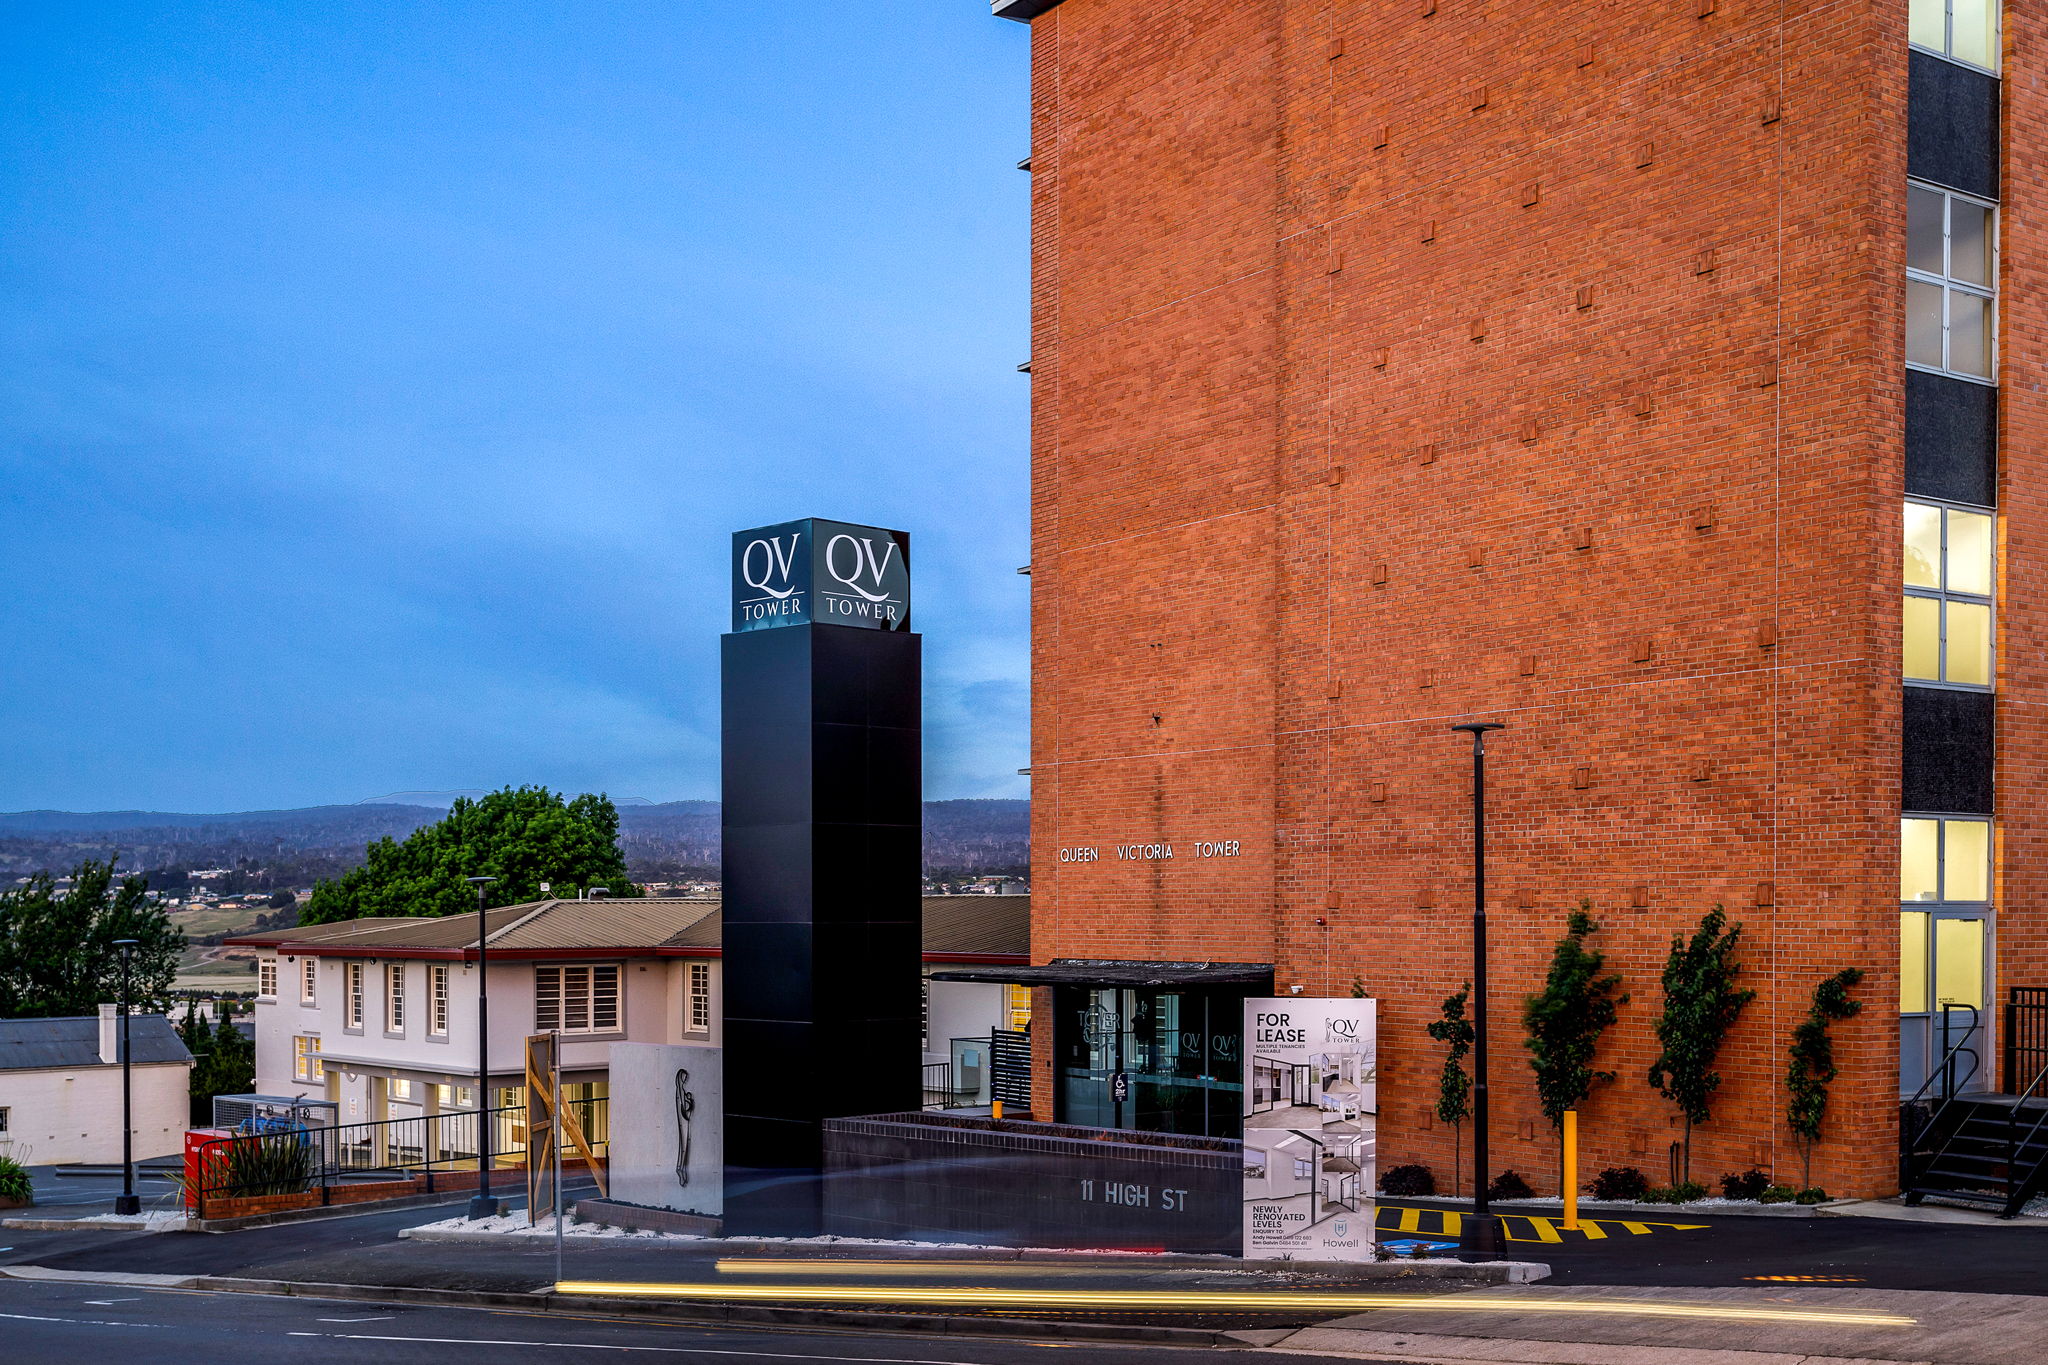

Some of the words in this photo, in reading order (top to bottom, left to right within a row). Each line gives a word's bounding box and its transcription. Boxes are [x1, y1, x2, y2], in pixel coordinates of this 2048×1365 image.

[742, 533, 801, 599] QV
[825, 534, 898, 602] QV
[742, 598, 801, 621] TOWER
[825, 597, 897, 621] TOWER
[1060, 846, 1100, 863] QUEEN
[1117, 844, 1174, 861] VICTORIA
[1194, 840, 1241, 859] TOWER
[1256, 1013, 1290, 1027] FOR
[1332, 1019, 1360, 1038] QV
[1182, 1032, 1201, 1053] QV
[1212, 1035, 1231, 1056] QV
[1256, 1029, 1306, 1043] LEASE
[1080, 1179, 1094, 1201] 11
[1105, 1181, 1150, 1208] HIGH
[1162, 1188, 1188, 1212] ST
[1252, 1205, 1283, 1213] NEWLY
[1252, 1213, 1306, 1221] RENOVATED
[1252, 1220, 1282, 1228] LEVELS
[1322, 1239, 1359, 1248] Howell
